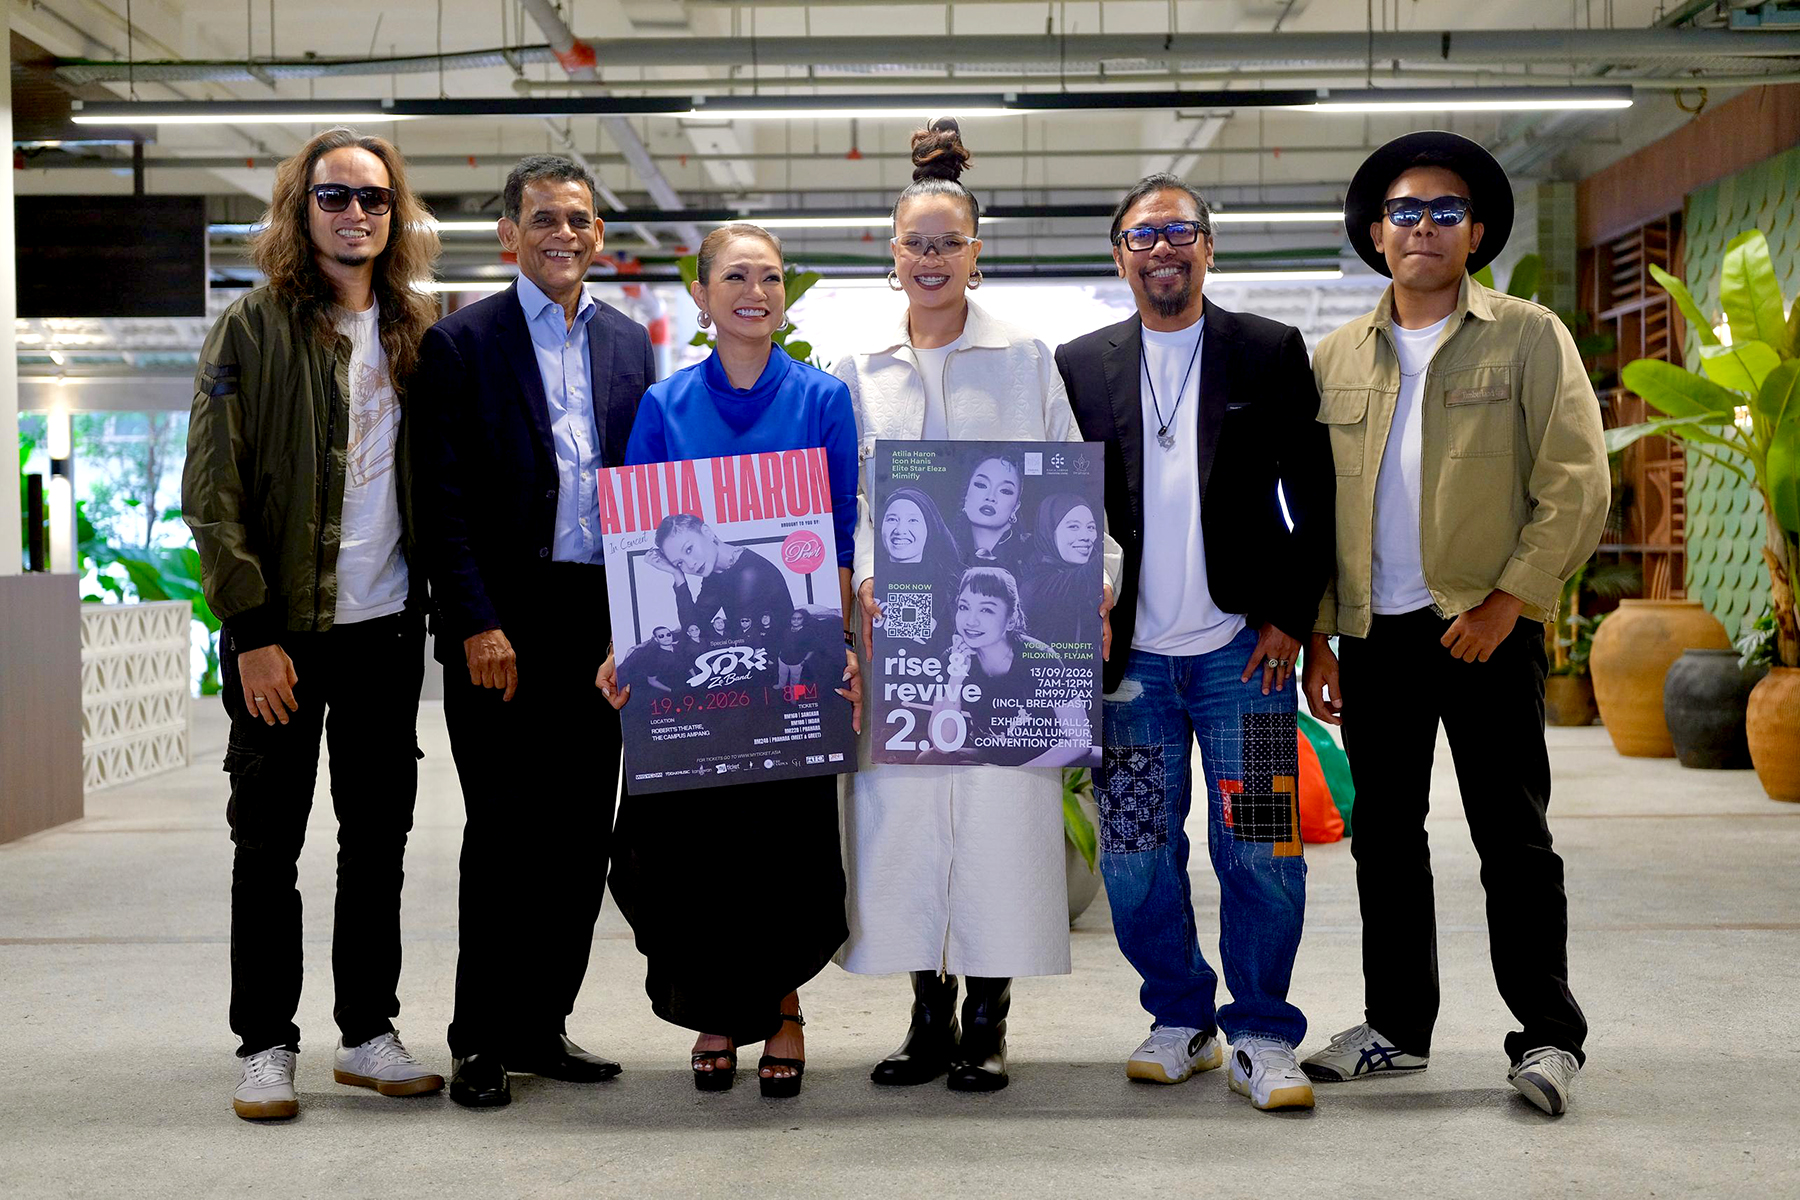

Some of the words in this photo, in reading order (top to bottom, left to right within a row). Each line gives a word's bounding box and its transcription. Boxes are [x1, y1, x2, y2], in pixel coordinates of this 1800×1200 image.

[711, 447, 833, 523] HARON
[609, 542, 618, 554] In
[620, 531, 648, 550] Concert
[710, 639, 727, 647] Special
[1051, 642, 1093, 650] POUNDFIT.
[885, 648, 942, 676] rise
[947, 652, 969, 677] &
[1030, 667, 1093, 678] 13/09/2026
[724, 671, 752, 686] Band
[1037, 678, 1093, 688] 7AM-12PM
[884, 675, 982, 703] revive
[1035, 689, 1093, 698] RM99/PAX
[651, 690, 750, 715] 19.9.2026
[783, 683, 817, 701] 8PM
[992, 698, 1024, 708] (INCL.
[1026, 699, 1092, 710] BREAKFAST)
[678, 723, 704, 732] THEATRE,
[991, 717, 1052, 727] EXHIBITION
[1055, 718, 1081, 727] HALL
[1083, 718, 1093, 728] 2,
[663, 732, 686, 740] CAMPUS
[687, 730, 710, 738] AMPANG
[885, 708, 967, 752] 2.0
[1007, 728, 1043, 737] KUALA
[1045, 728, 1092, 738] LUMPUR,
[974, 737, 1048, 747] CONVENTION
[1050, 738, 1092, 748] CENTRE
